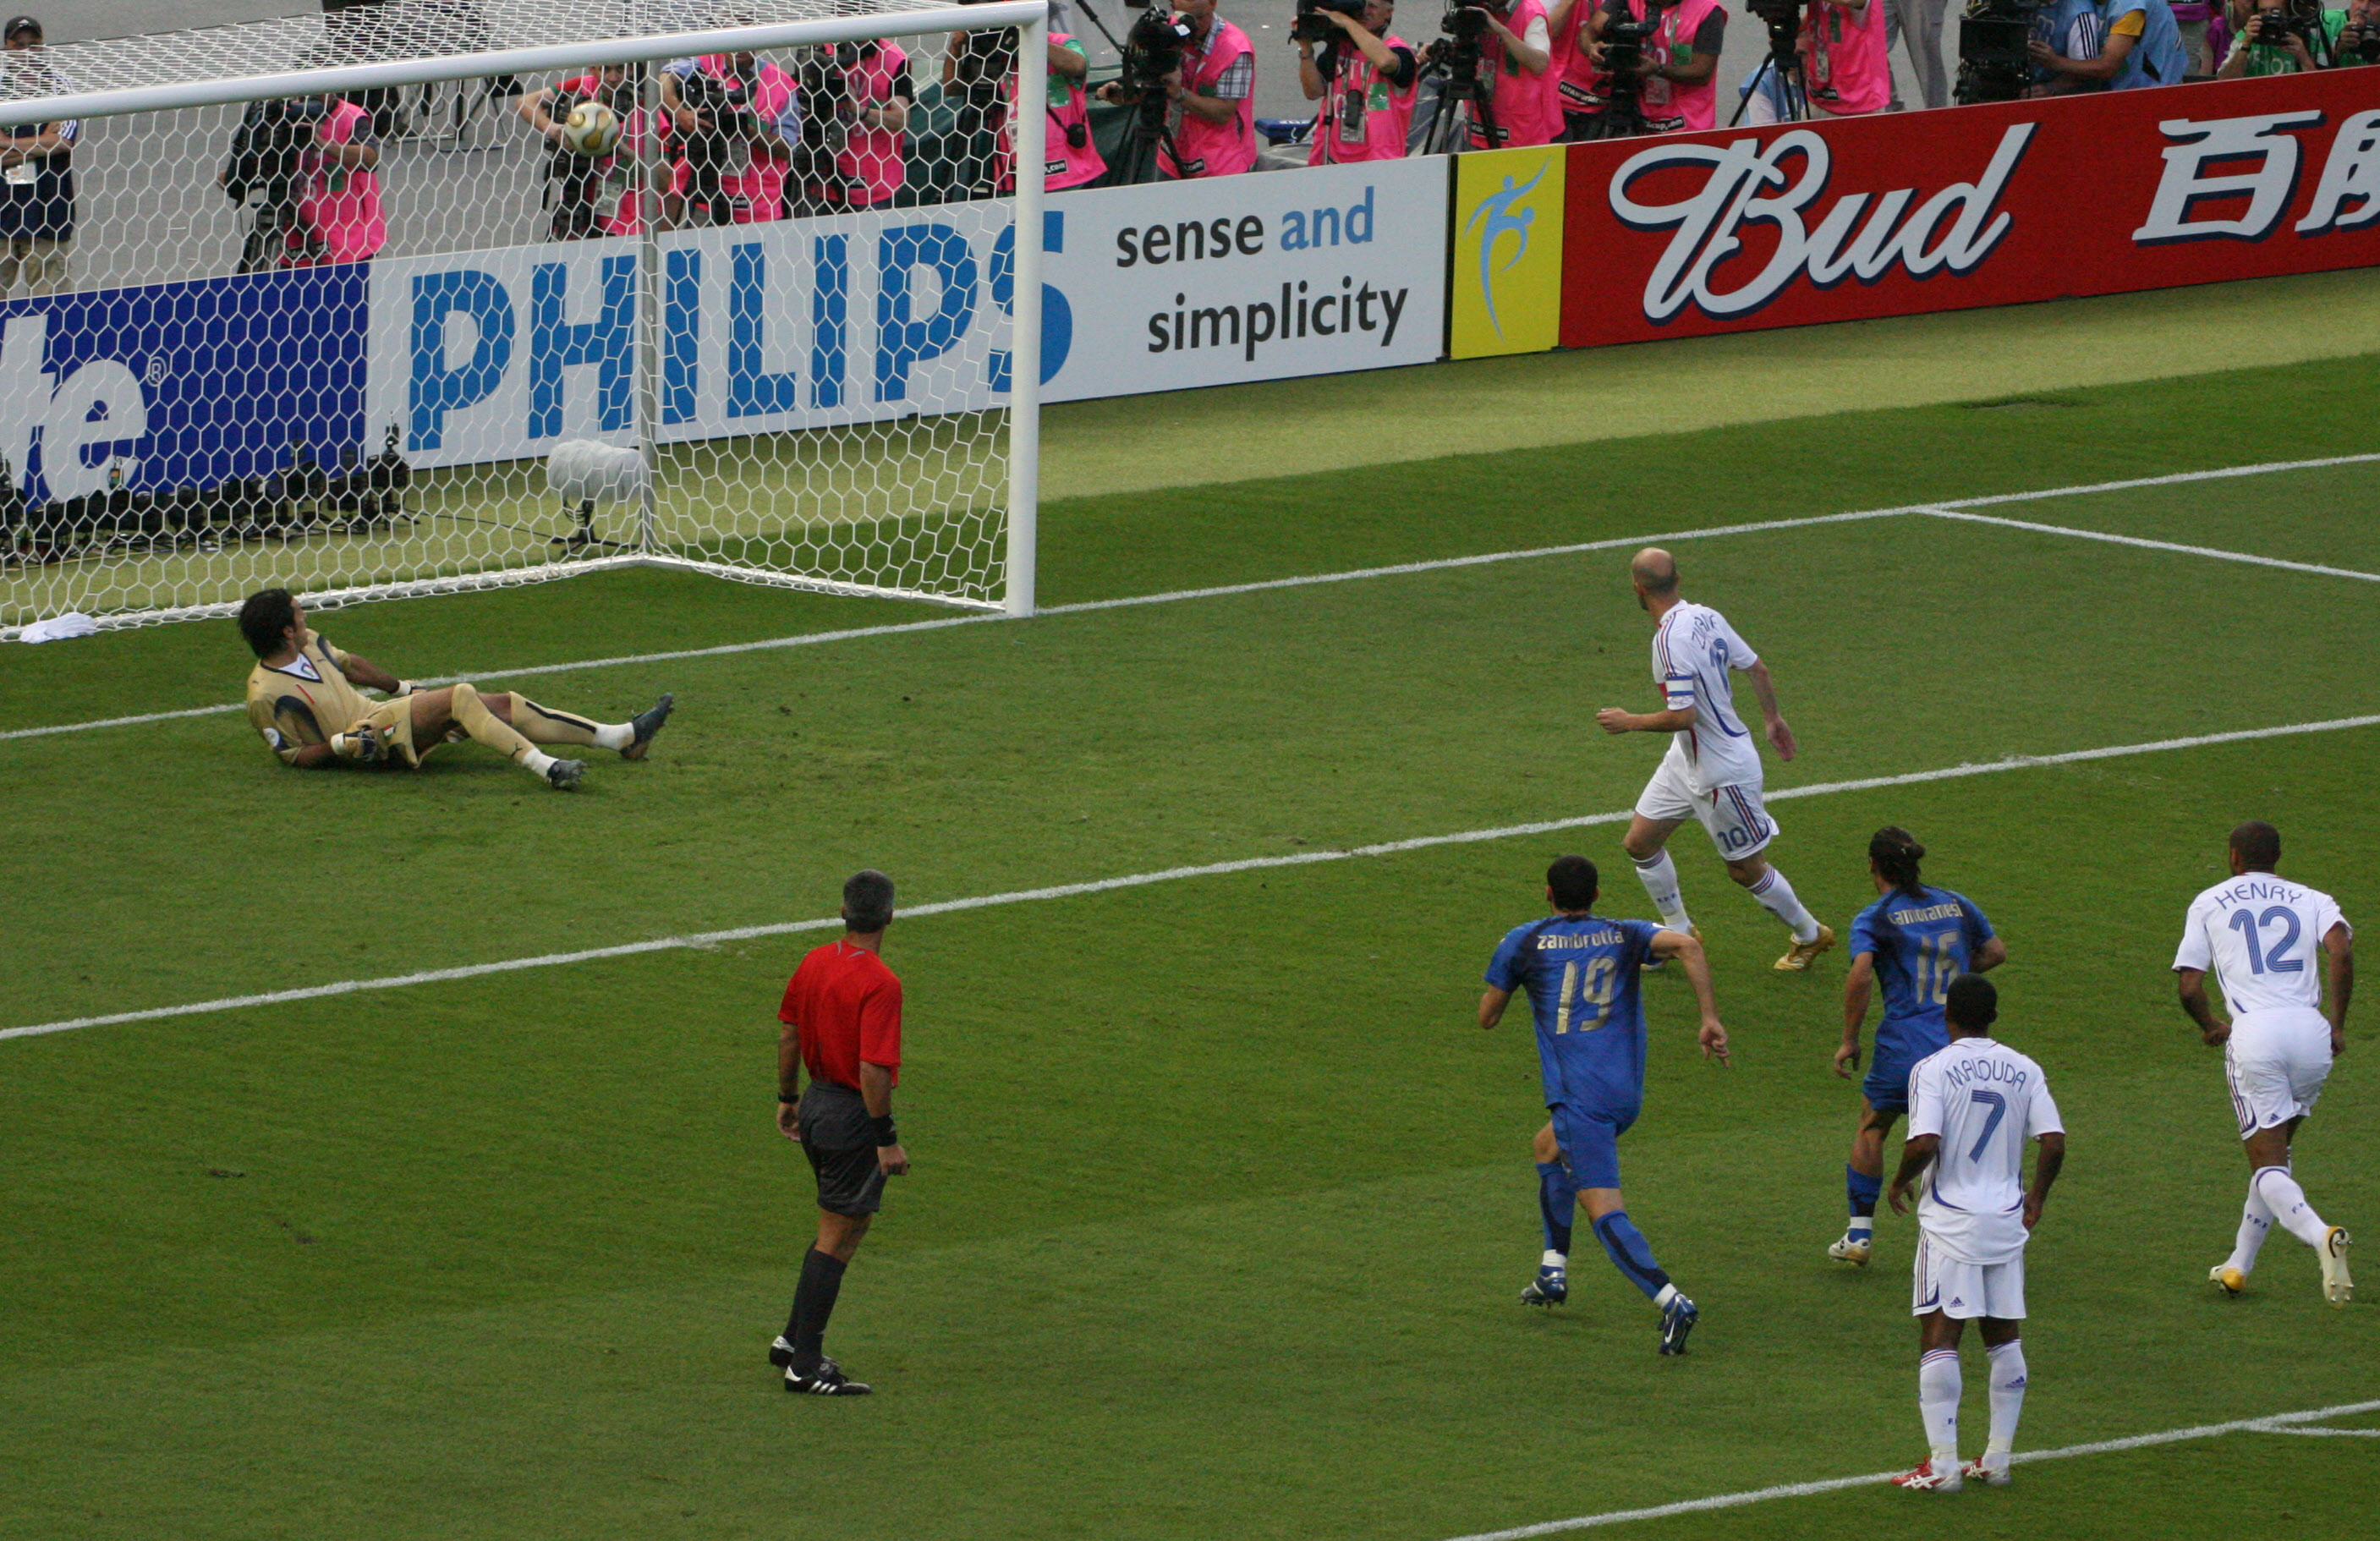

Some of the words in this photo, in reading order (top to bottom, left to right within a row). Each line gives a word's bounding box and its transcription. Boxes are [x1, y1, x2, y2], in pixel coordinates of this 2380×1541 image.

[1116, 214, 1264, 268] sense
[1280, 185, 1375, 252] and
[1609, 122, 2036, 319] Bud
[408, 210, 1073, 452] PHILIPS
[1148, 275, 1409, 362] simplicity
[1717, 826, 1748, 853] 10
[2213, 882, 2302, 910] HENRY
[1536, 930, 1625, 950] zambrotta
[1916, 930, 1959, 1006] 16
[2228, 905, 2303, 975] 12
[1556, 956, 1616, 1035] 19
[1945, 1058, 2026, 1093] MALOUDA
[1968, 1089, 2006, 1165] 7
